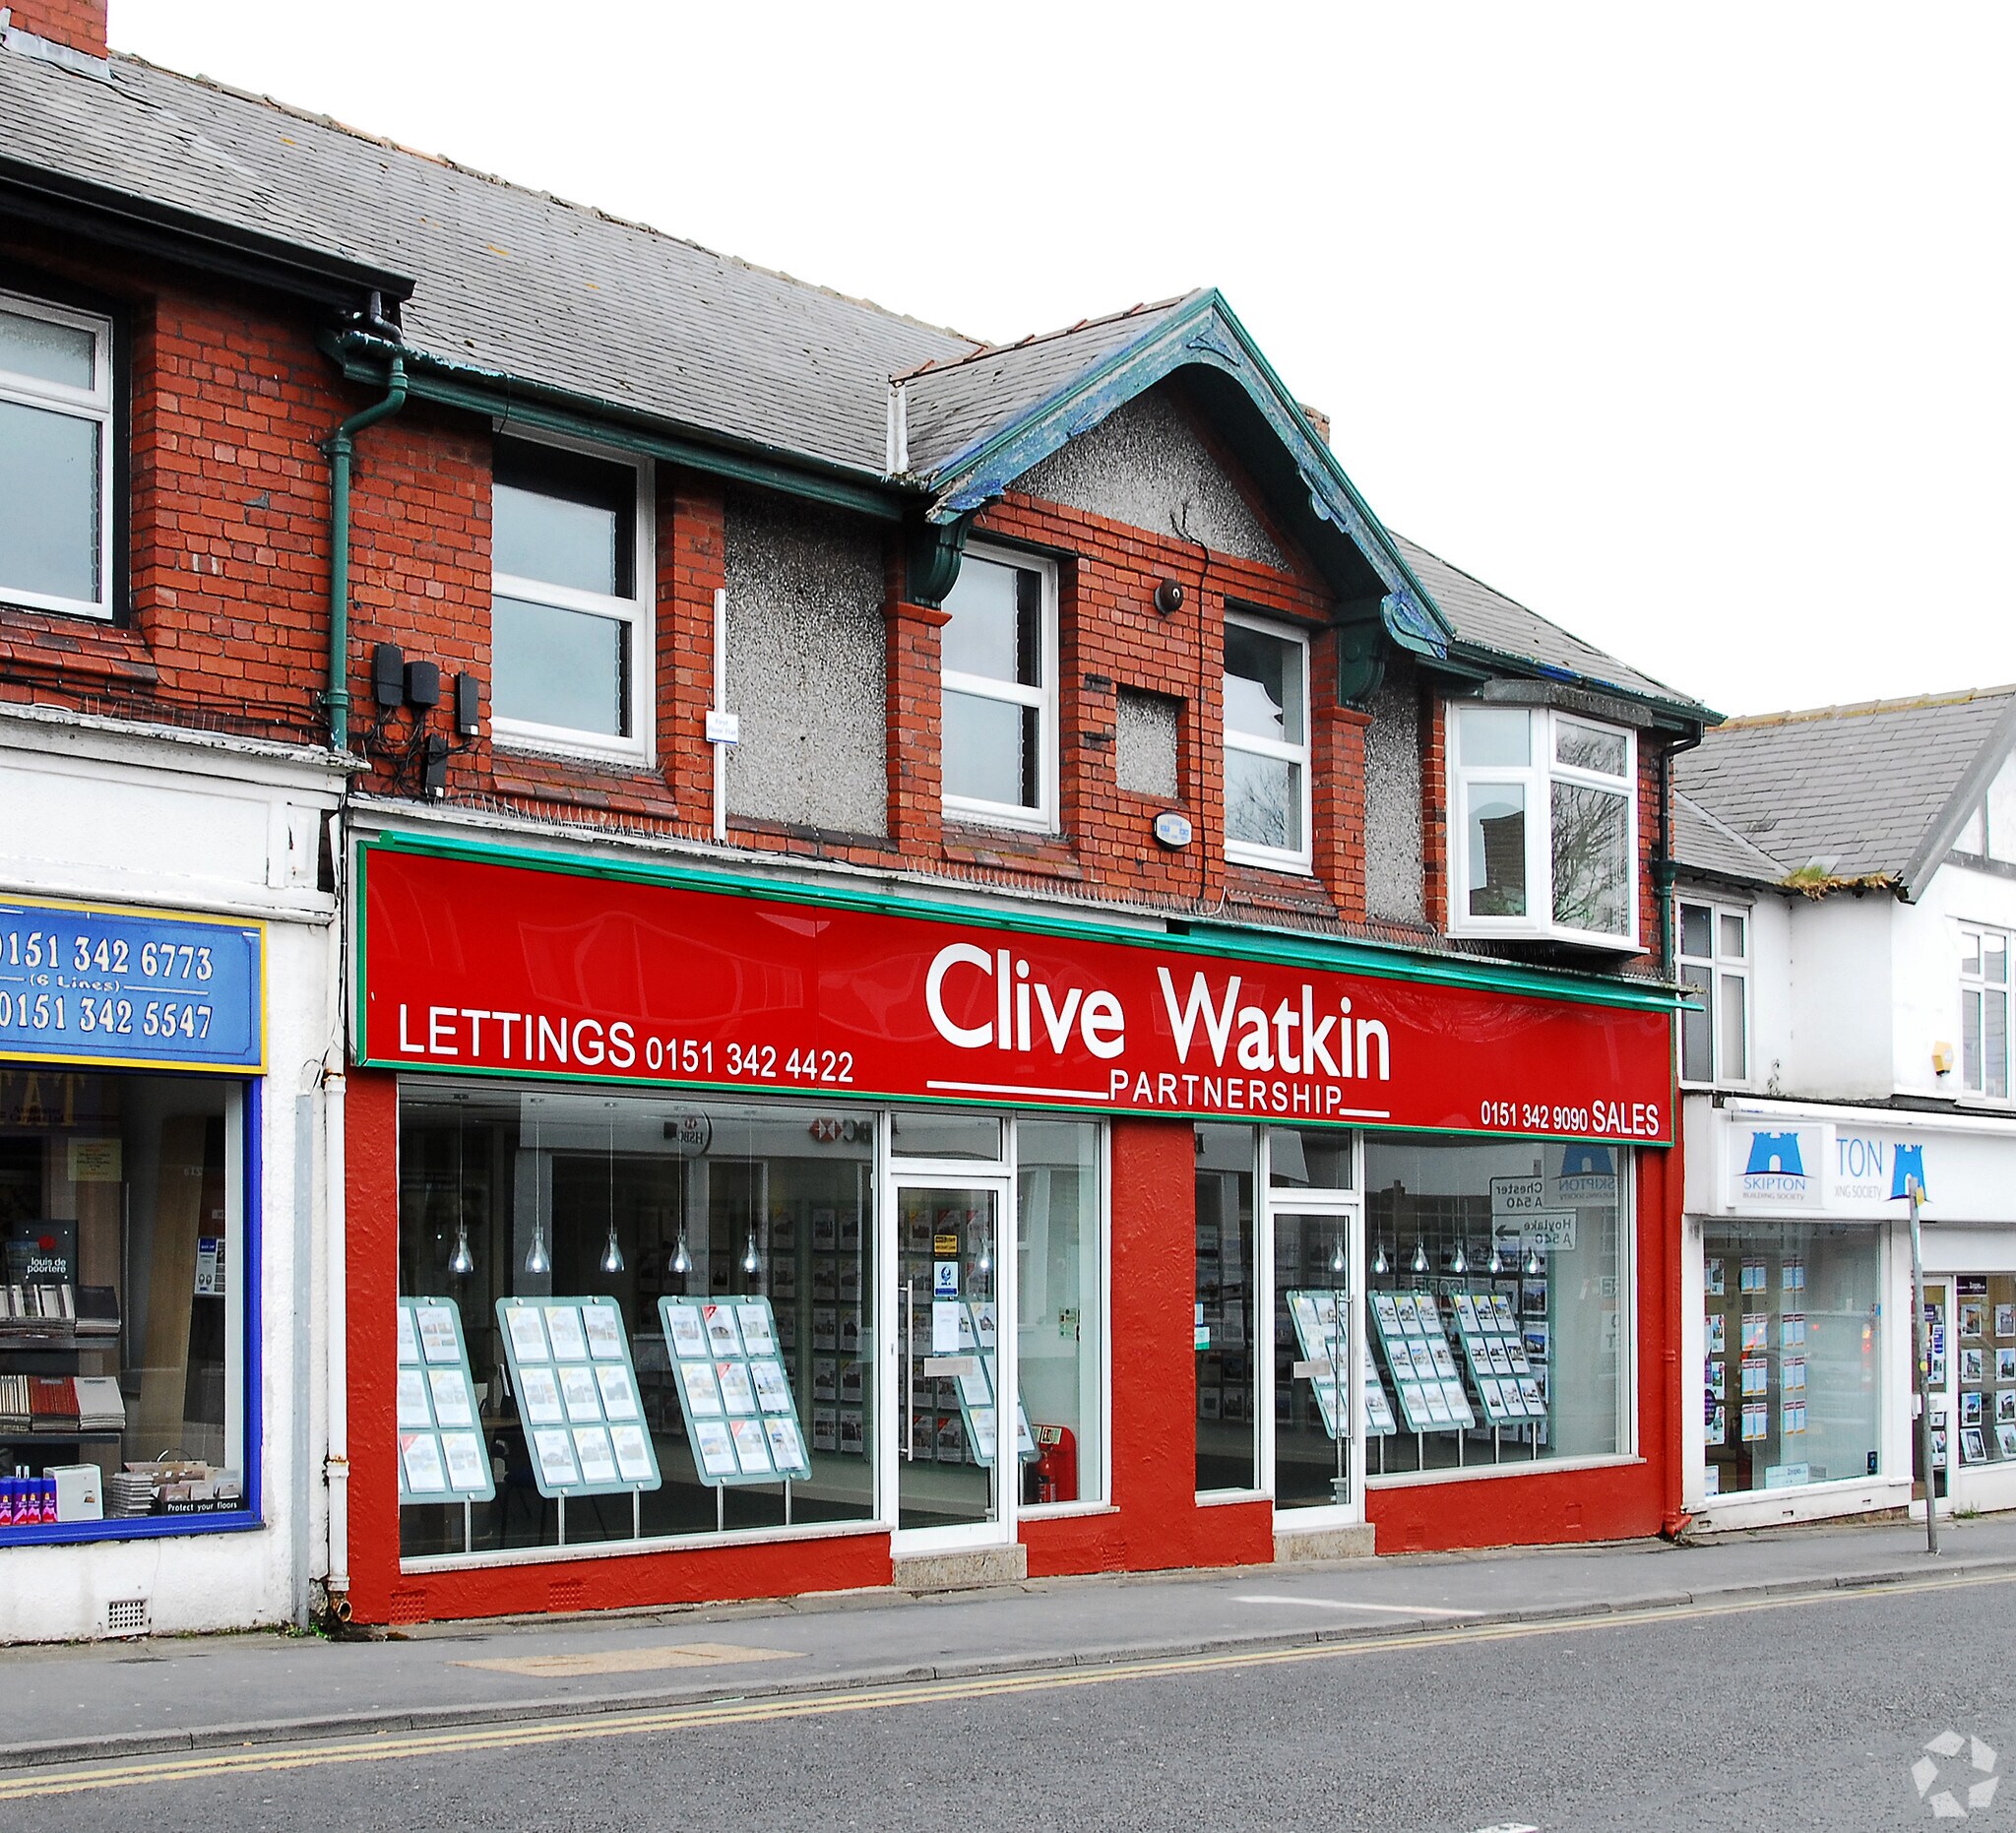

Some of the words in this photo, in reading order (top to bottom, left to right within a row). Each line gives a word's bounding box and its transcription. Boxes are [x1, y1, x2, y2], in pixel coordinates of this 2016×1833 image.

[0, 930, 59, 969] 151
[73, 936, 129, 974] 342
[141, 941, 213, 981] 6773
[29, 974, 49, 987] (6
[57, 975, 121, 993] Lines)
[0, 990, 66, 1031] 0151
[79, 996, 133, 1035] 342
[143, 1001, 213, 1040] 5547
[925, 942, 1126, 1060] Clive
[1156, 966, 1391, 1082] Watkin
[399, 1003, 636, 1069] LETTINGS
[645, 1036, 713, 1075] 0151
[725, 1043, 777, 1078] 342
[785, 1047, 853, 1084] 4422
[1109, 1068, 1342, 1115] PARTNERSHIP
[1480, 1100, 1517, 1127] 0151
[1522, 1104, 1549, 1129] 342
[1552, 1106, 1588, 1132] 9090
[1592, 1100, 1660, 1136] SALES
[1836, 1138, 1882, 1177] TON
[1743, 1176, 1805, 1191] SKIPTON
[1852, 1184, 1881, 1201] SOCIETY
[31, 1256, 53, 1266] louis
[54, 1256, 66, 1266] de
[167, 1503, 194, 1512] Protect
[197, 1502, 214, 1513] your
[217, 1501, 237, 1510] floors
